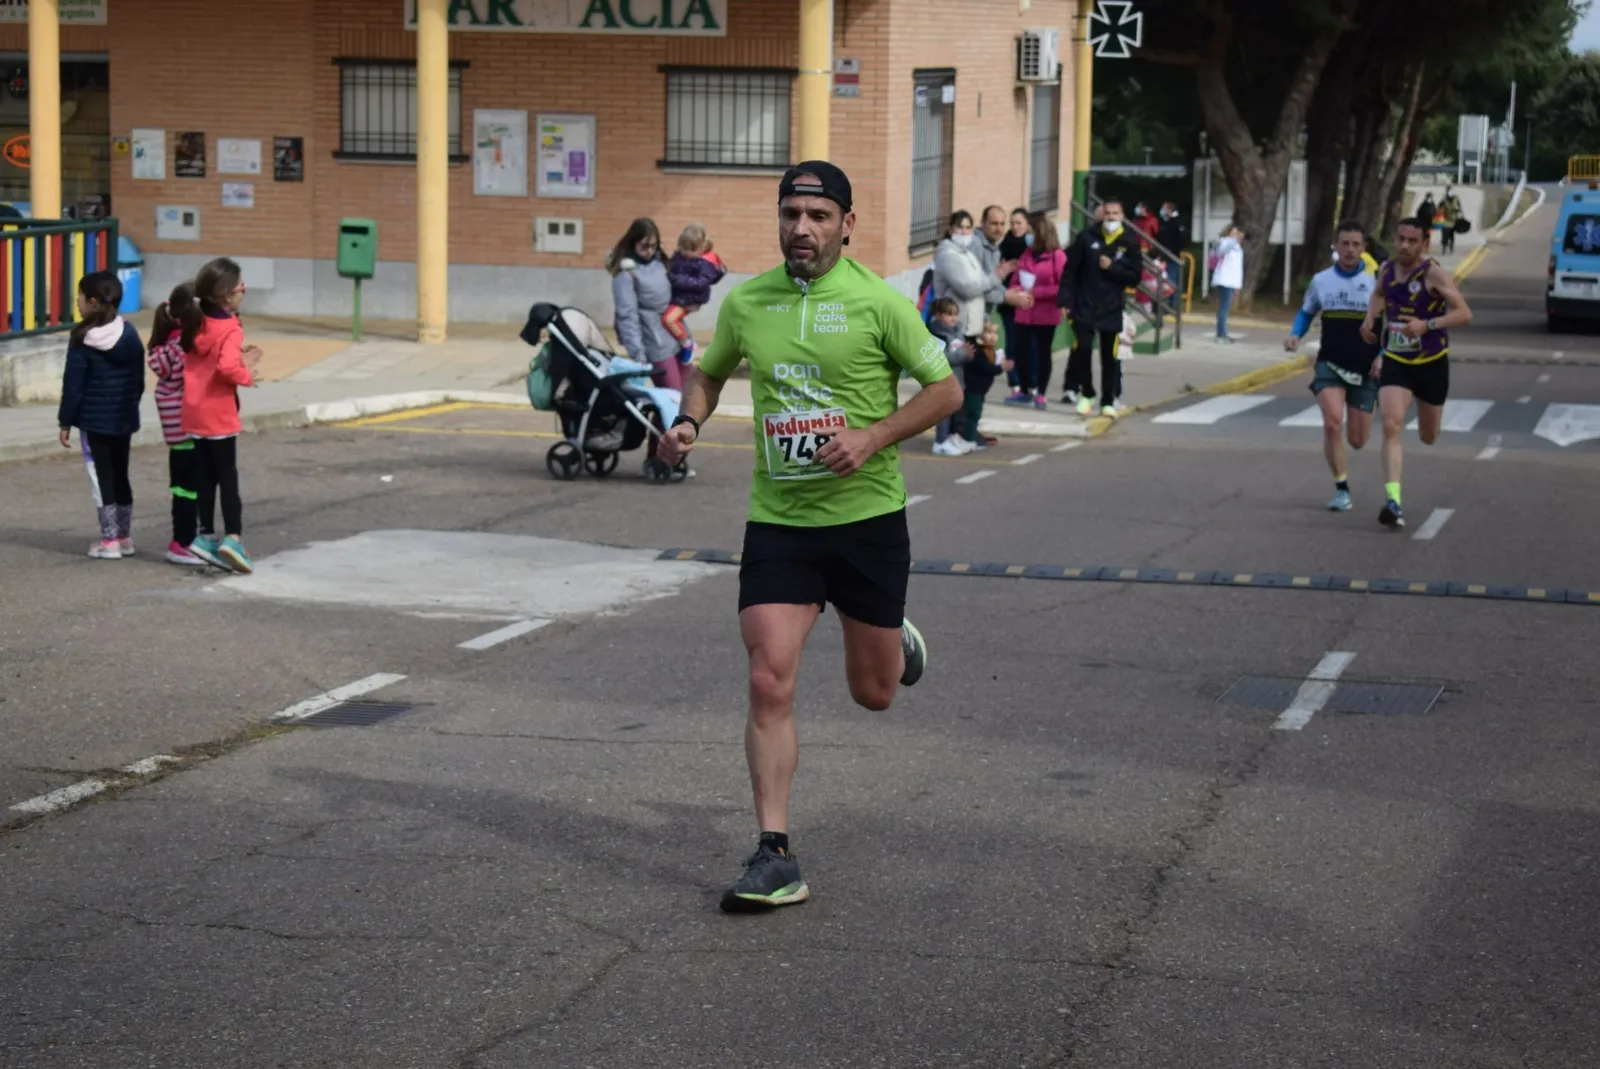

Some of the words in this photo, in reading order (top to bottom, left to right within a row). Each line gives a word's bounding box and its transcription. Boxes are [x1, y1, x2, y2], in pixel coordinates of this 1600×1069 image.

[817, 303, 844, 312] pan
[815, 311, 847, 322] cake
[813, 322, 848, 333] team
[773, 363, 821, 381] pan
